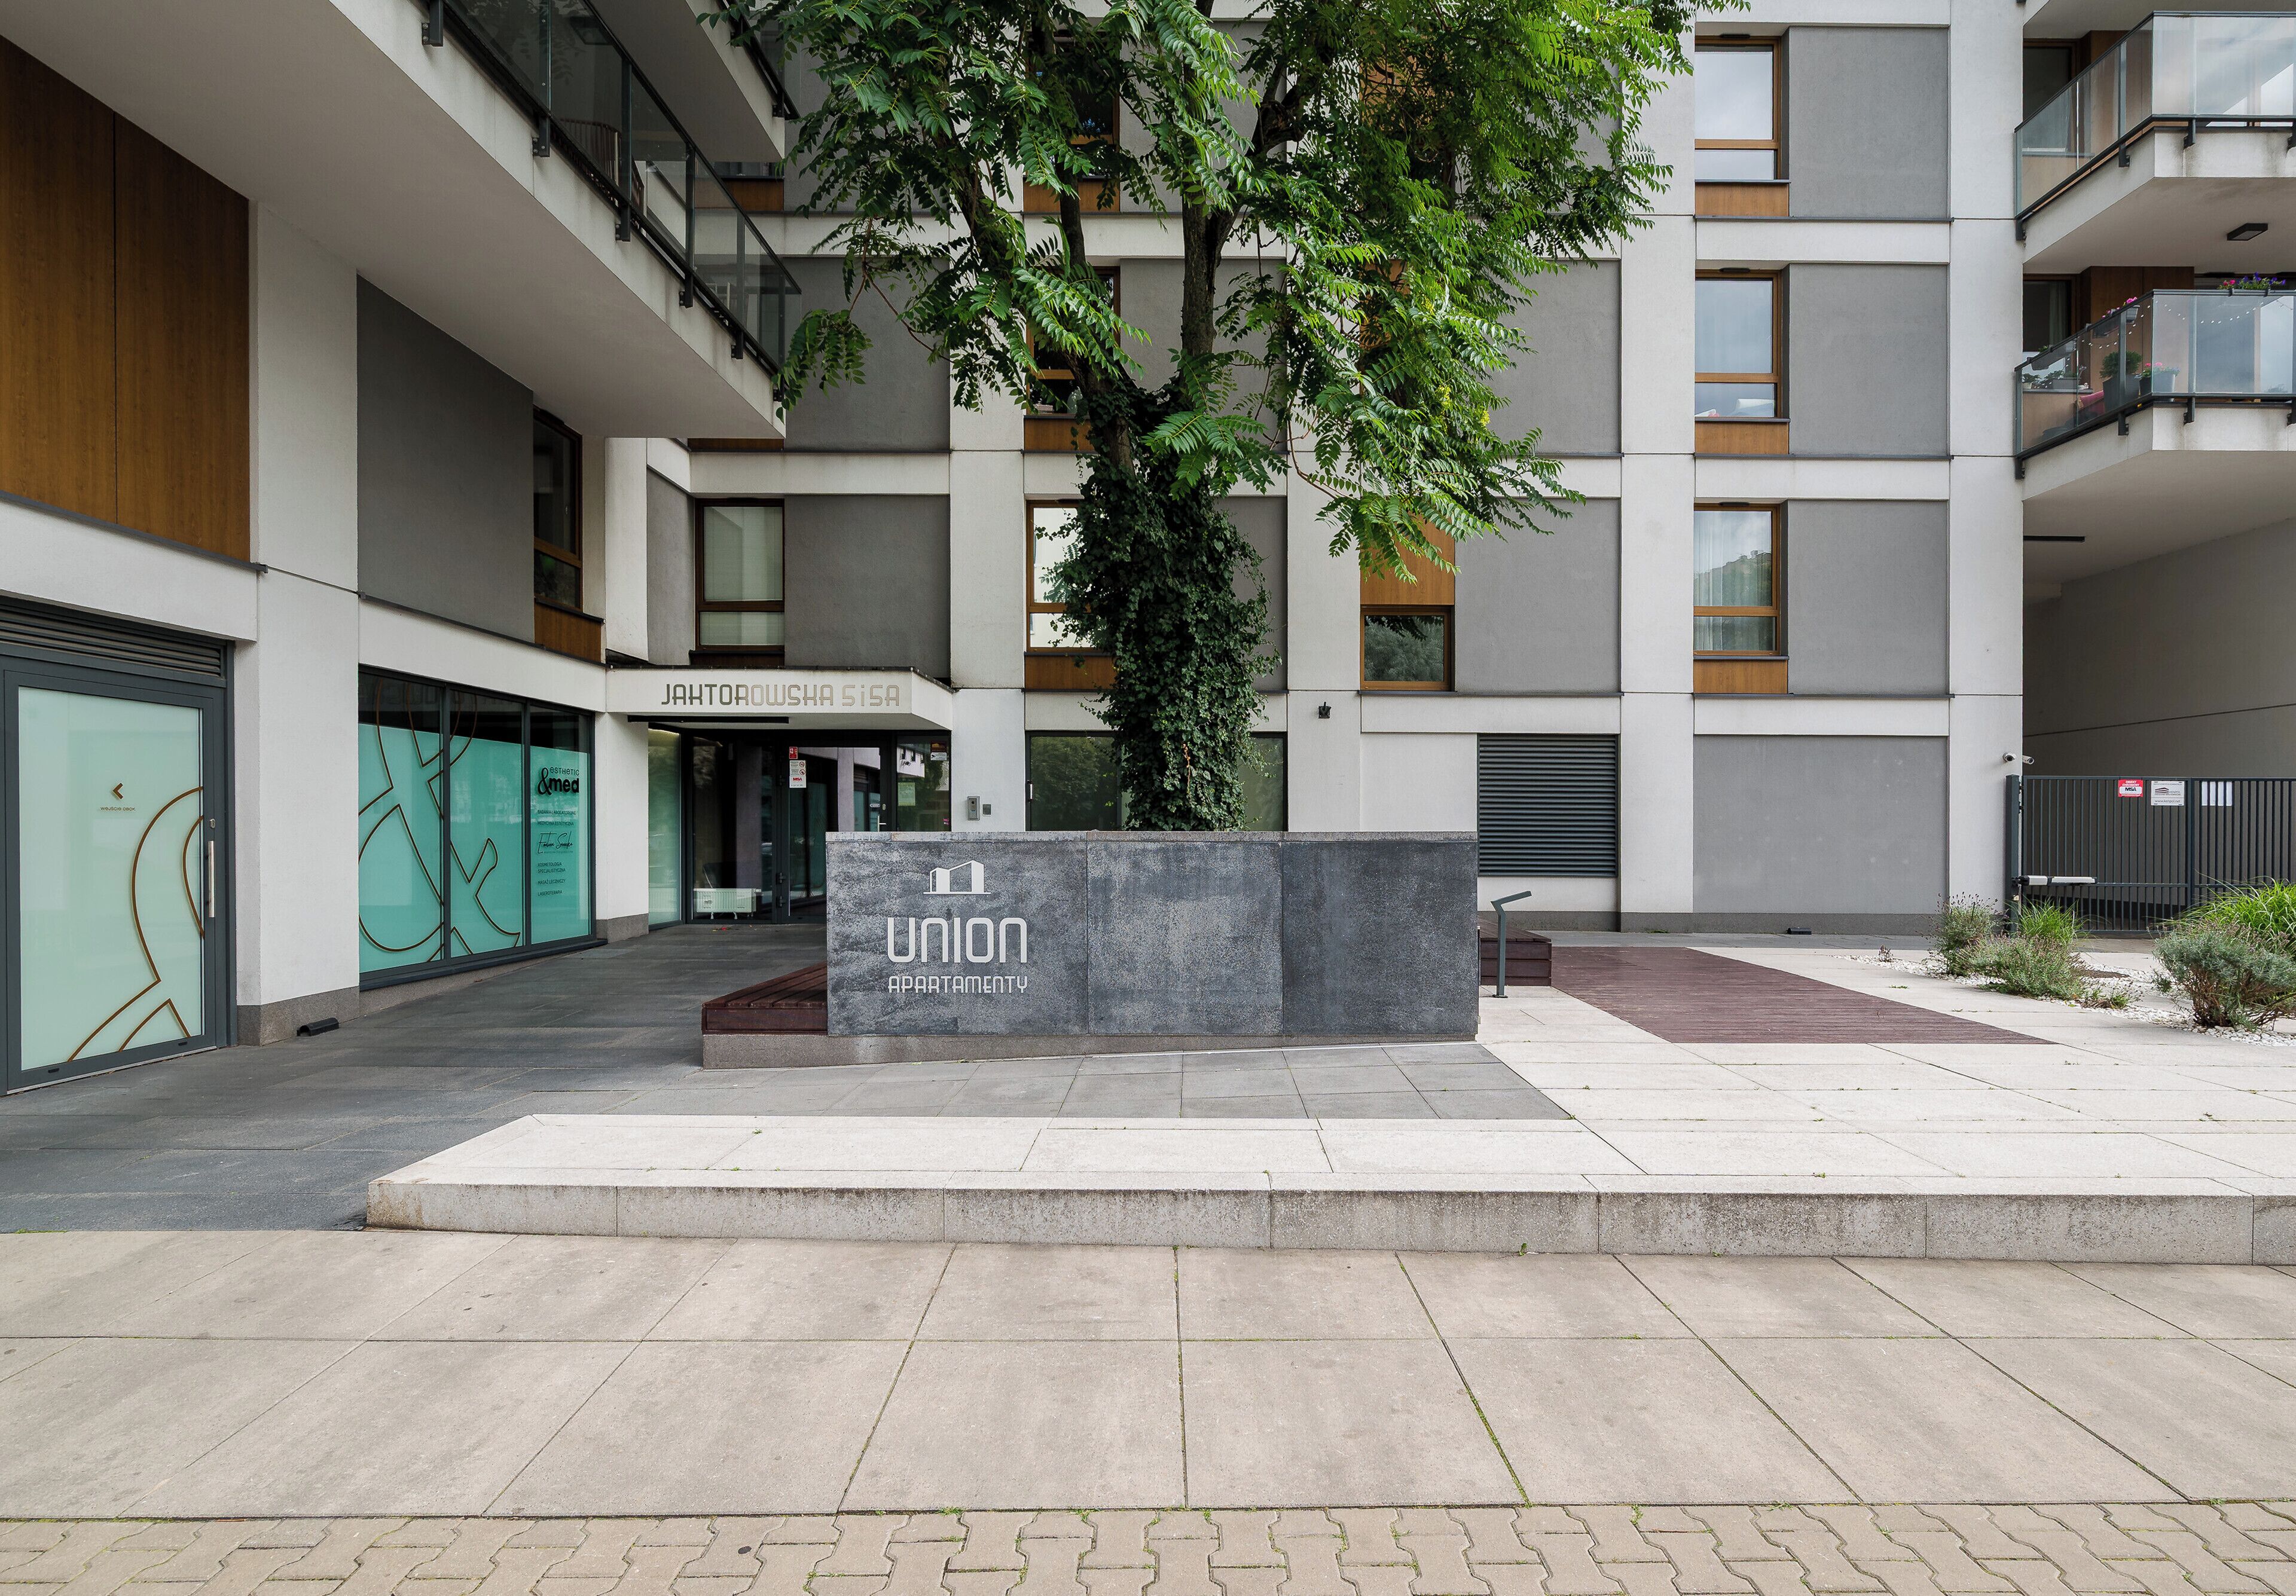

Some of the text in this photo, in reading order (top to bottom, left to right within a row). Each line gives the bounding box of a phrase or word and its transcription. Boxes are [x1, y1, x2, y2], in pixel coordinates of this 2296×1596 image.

[661, 683, 833, 706] JAKTOROWSKA
[842, 684, 856, 707] 5
[869, 684, 900, 707] 5A
[887, 917, 1027, 963] UNION
[888, 976, 1028, 993] APARTAMENTY
